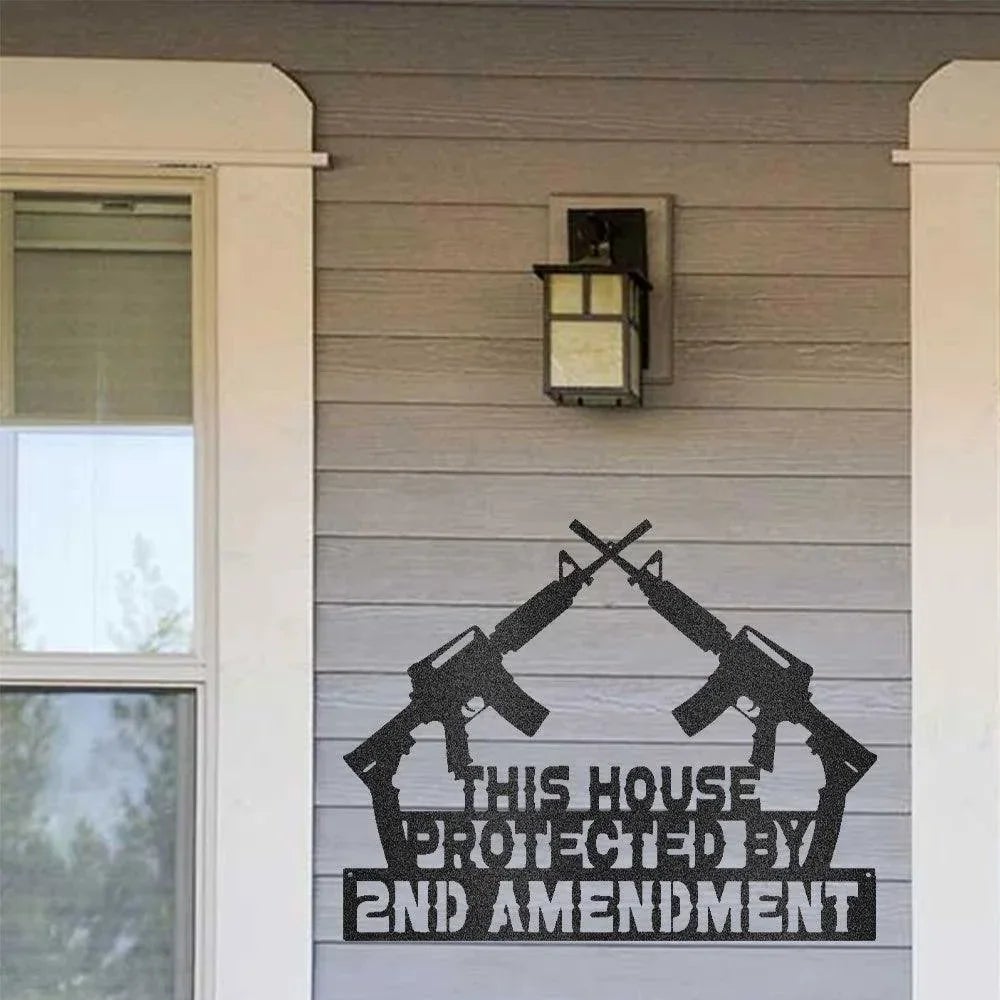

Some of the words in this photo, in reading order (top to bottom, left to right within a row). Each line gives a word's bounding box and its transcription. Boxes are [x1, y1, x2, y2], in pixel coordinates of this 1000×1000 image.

[455, 765, 570, 812] THIS
[589, 765, 761, 812] HOUSE
[405, 819, 726, 869] PROTECTED
[744, 819, 815, 869] BY
[356, 880, 469, 933] 2ND
[487, 880, 859, 933] AMENDMENT
